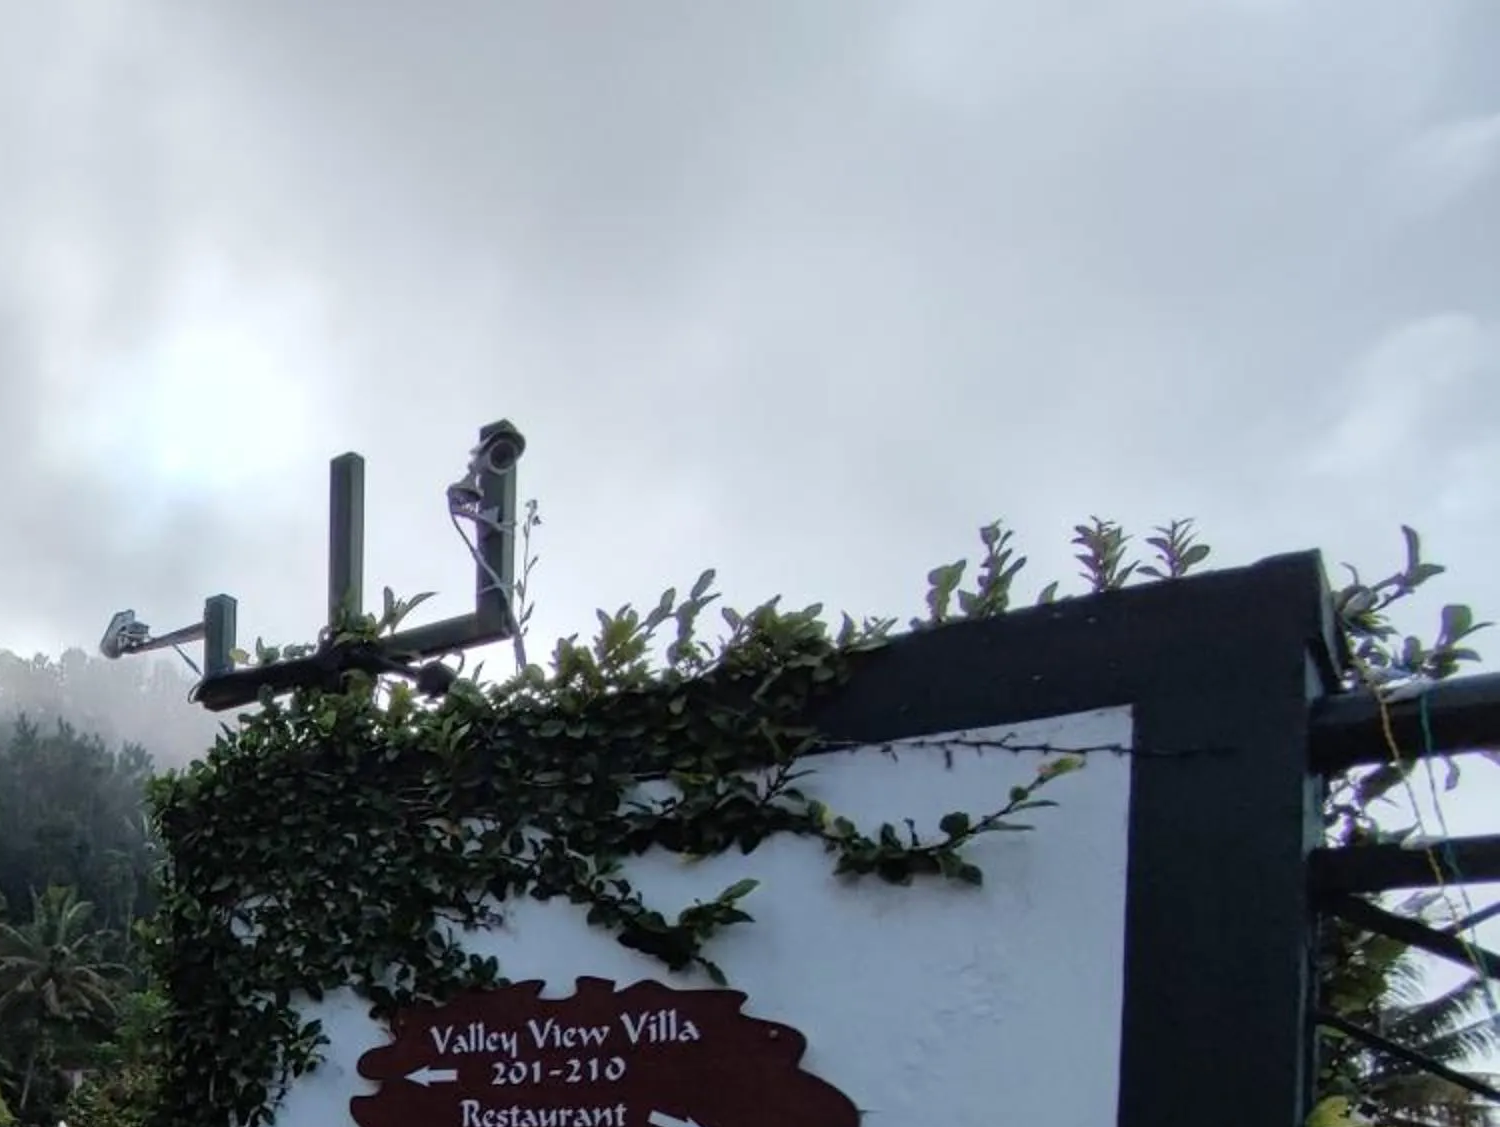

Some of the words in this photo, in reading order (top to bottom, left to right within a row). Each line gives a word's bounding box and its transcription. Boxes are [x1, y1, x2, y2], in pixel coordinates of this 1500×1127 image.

[431, 1024, 518, 1058] Valley
[529, 1017, 609, 1049] View
[620, 1009, 700, 1044] Villa
[491, 1057, 626, 1085] 201-210
[461, 1100, 627, 1127] Restaurant
